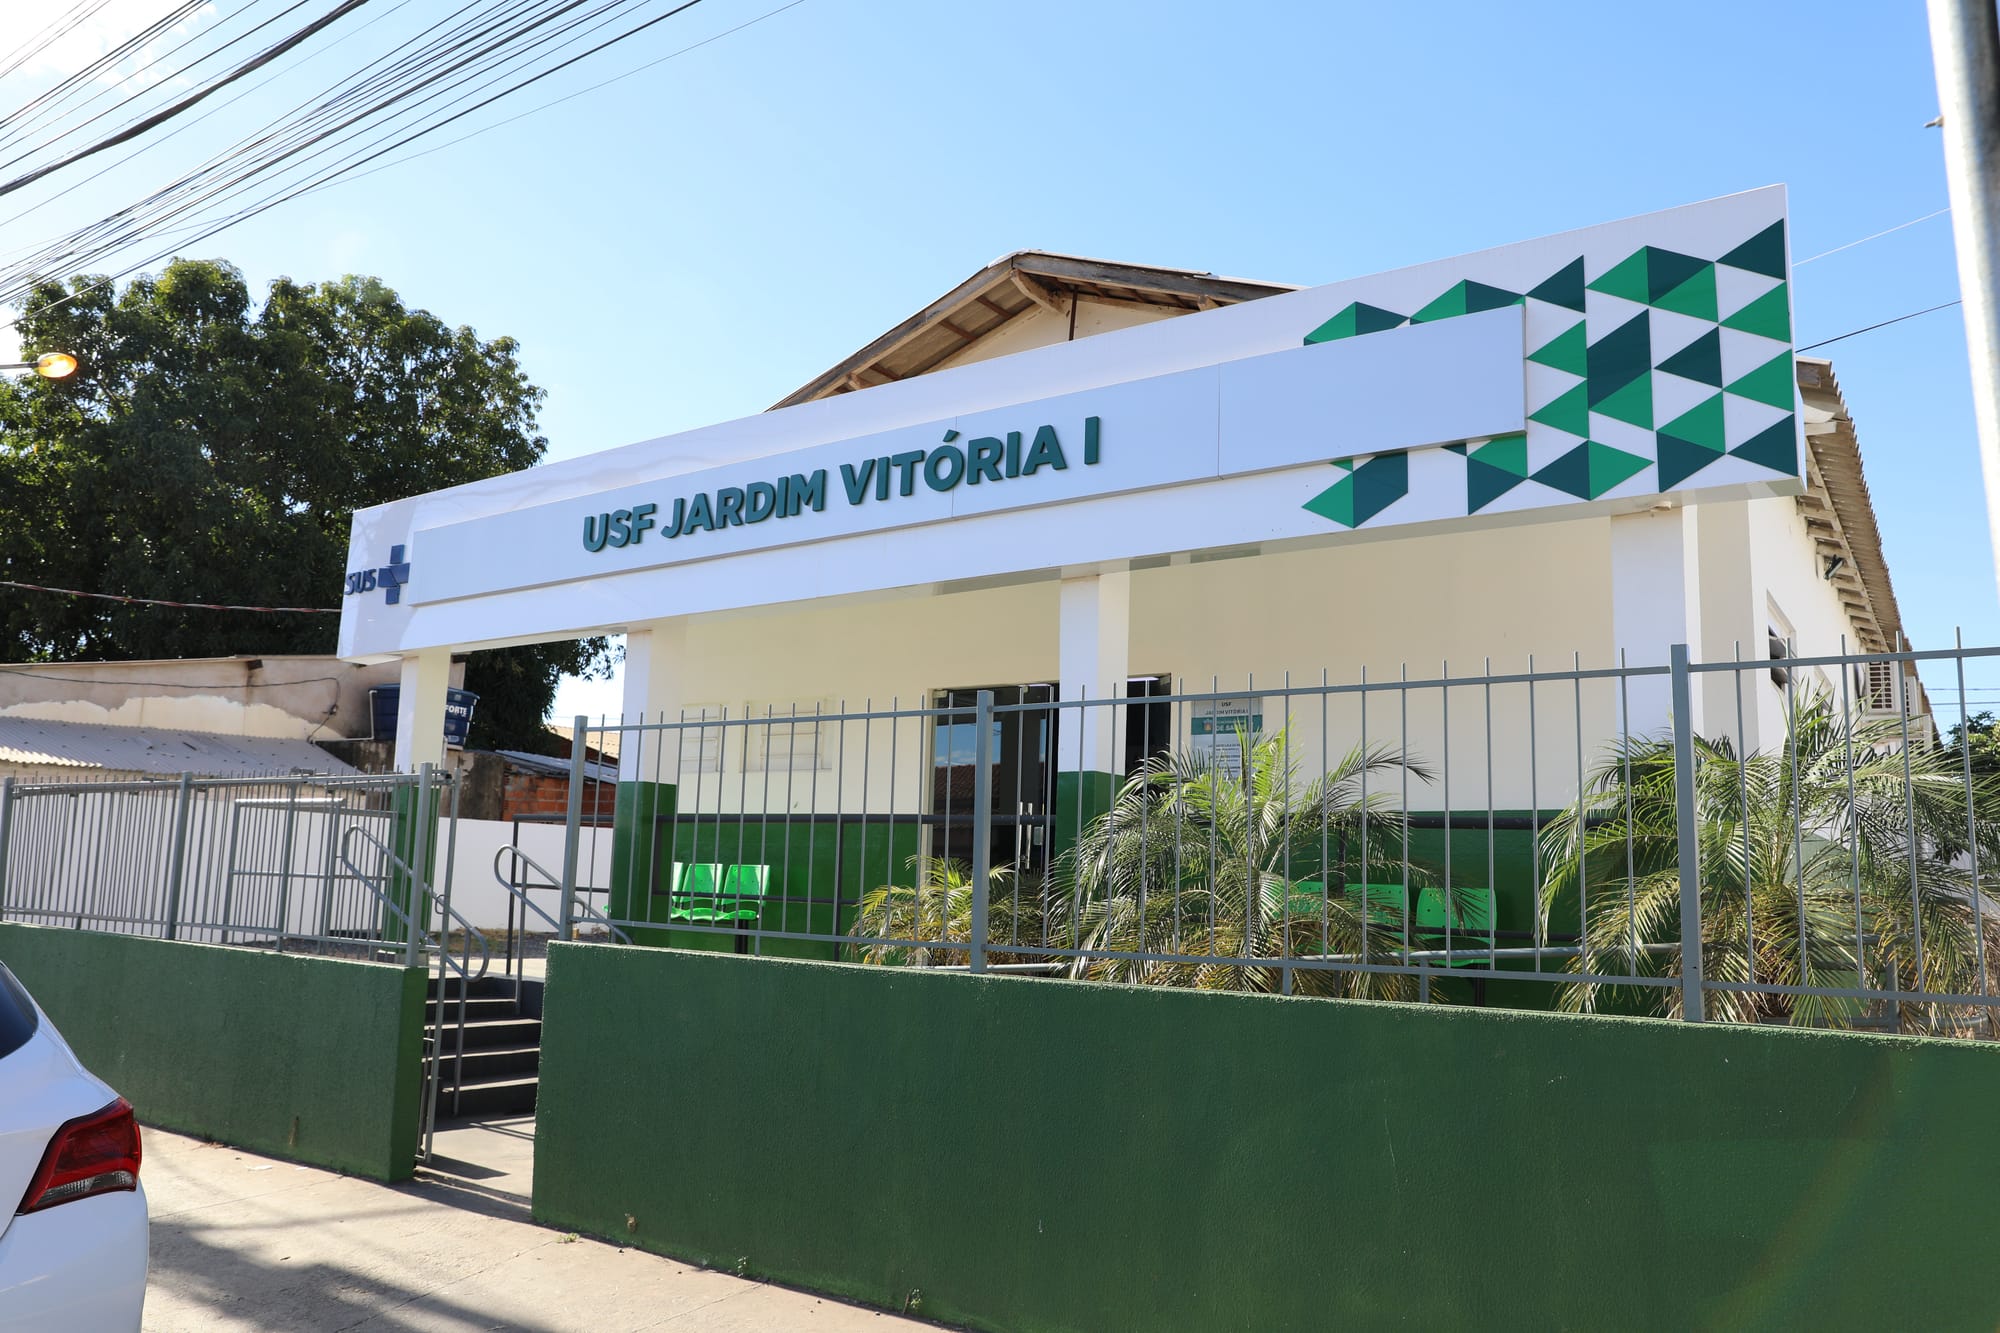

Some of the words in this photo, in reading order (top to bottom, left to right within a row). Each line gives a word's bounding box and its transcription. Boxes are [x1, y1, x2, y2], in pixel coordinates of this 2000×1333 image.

[583, 503, 655, 552] USF
[660, 468, 826, 538] JARDIM
[840, 424, 1067, 504] VITÓRIA
[1083, 415, 1100, 465] I
[344, 569, 377, 595] SUS
